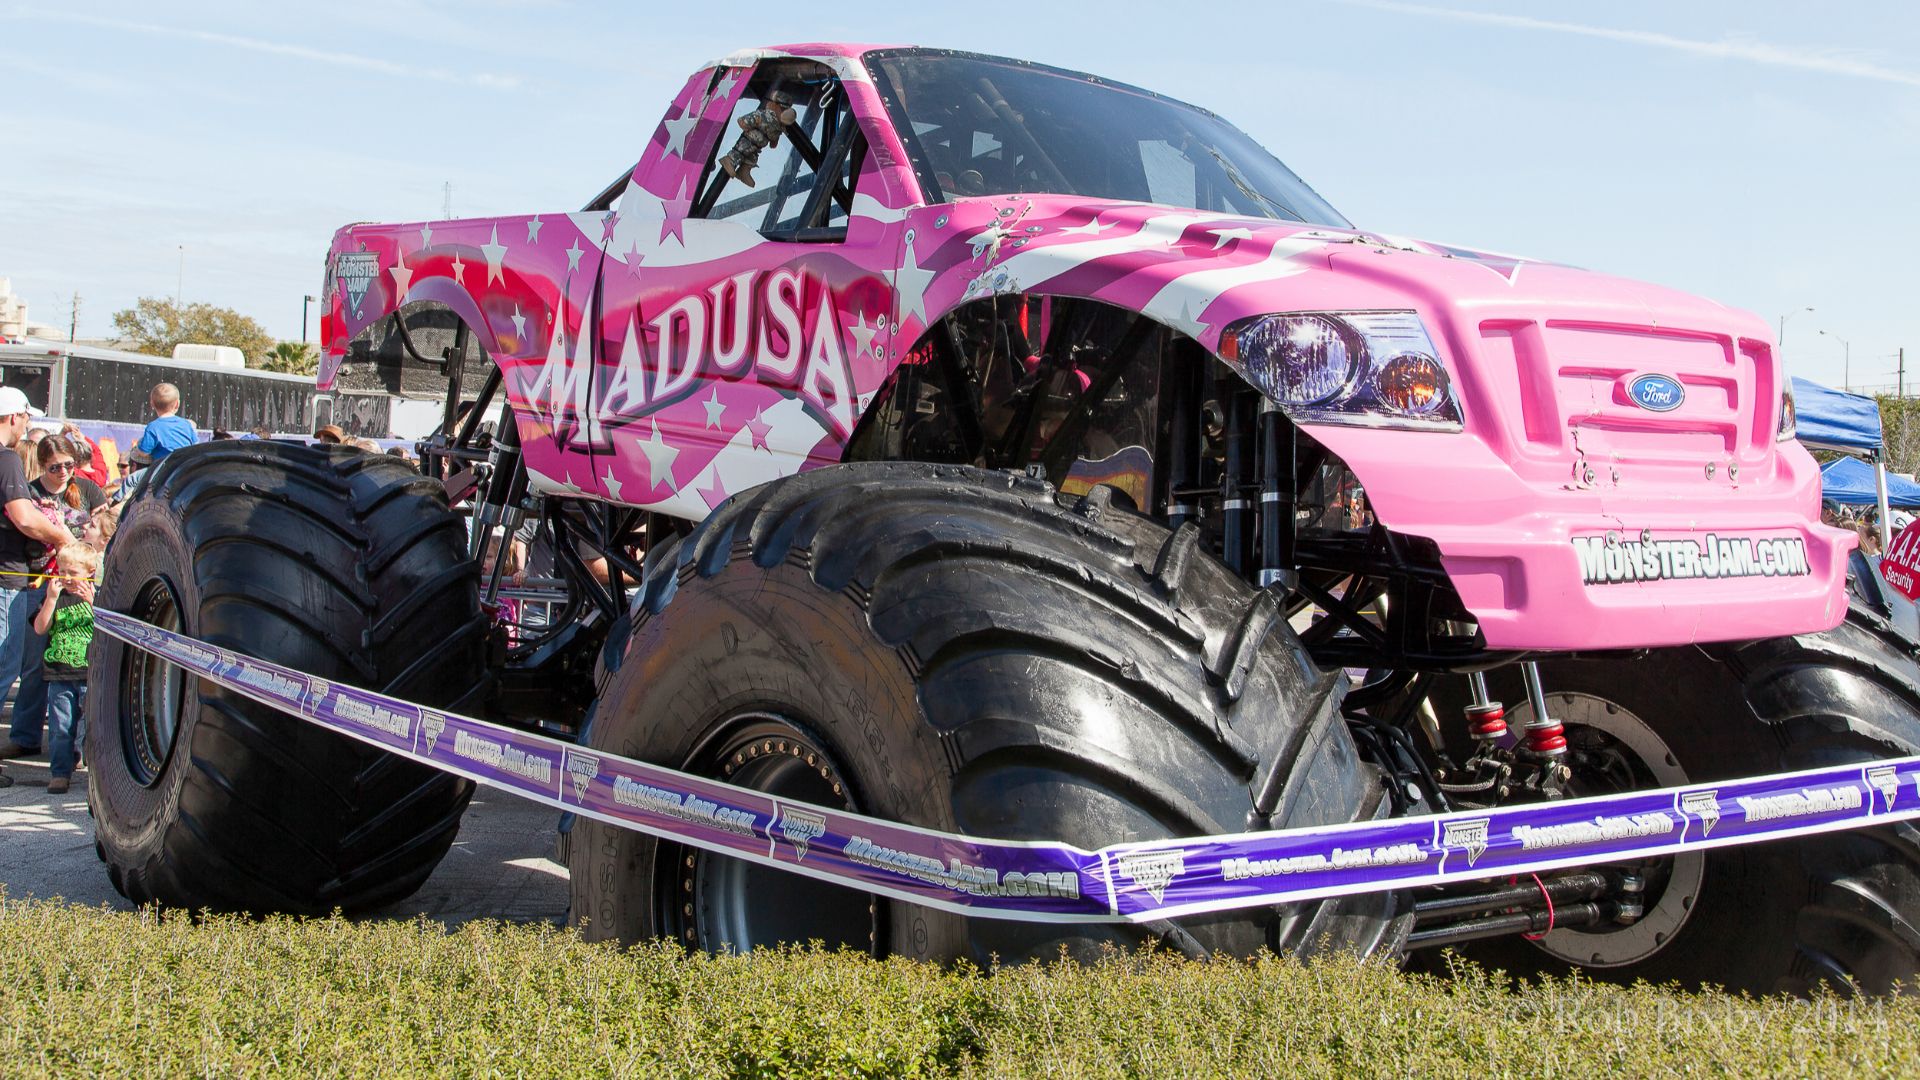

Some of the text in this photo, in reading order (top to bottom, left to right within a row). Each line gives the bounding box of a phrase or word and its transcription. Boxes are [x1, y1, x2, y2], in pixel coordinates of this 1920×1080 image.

[337, 260, 379, 277] MONSTER
[346, 277, 371, 293] JAM
[517, 262, 857, 450] MADUSA
[1642, 381, 1672, 404] Ford
[1886, 565, 1913, 594] Security
